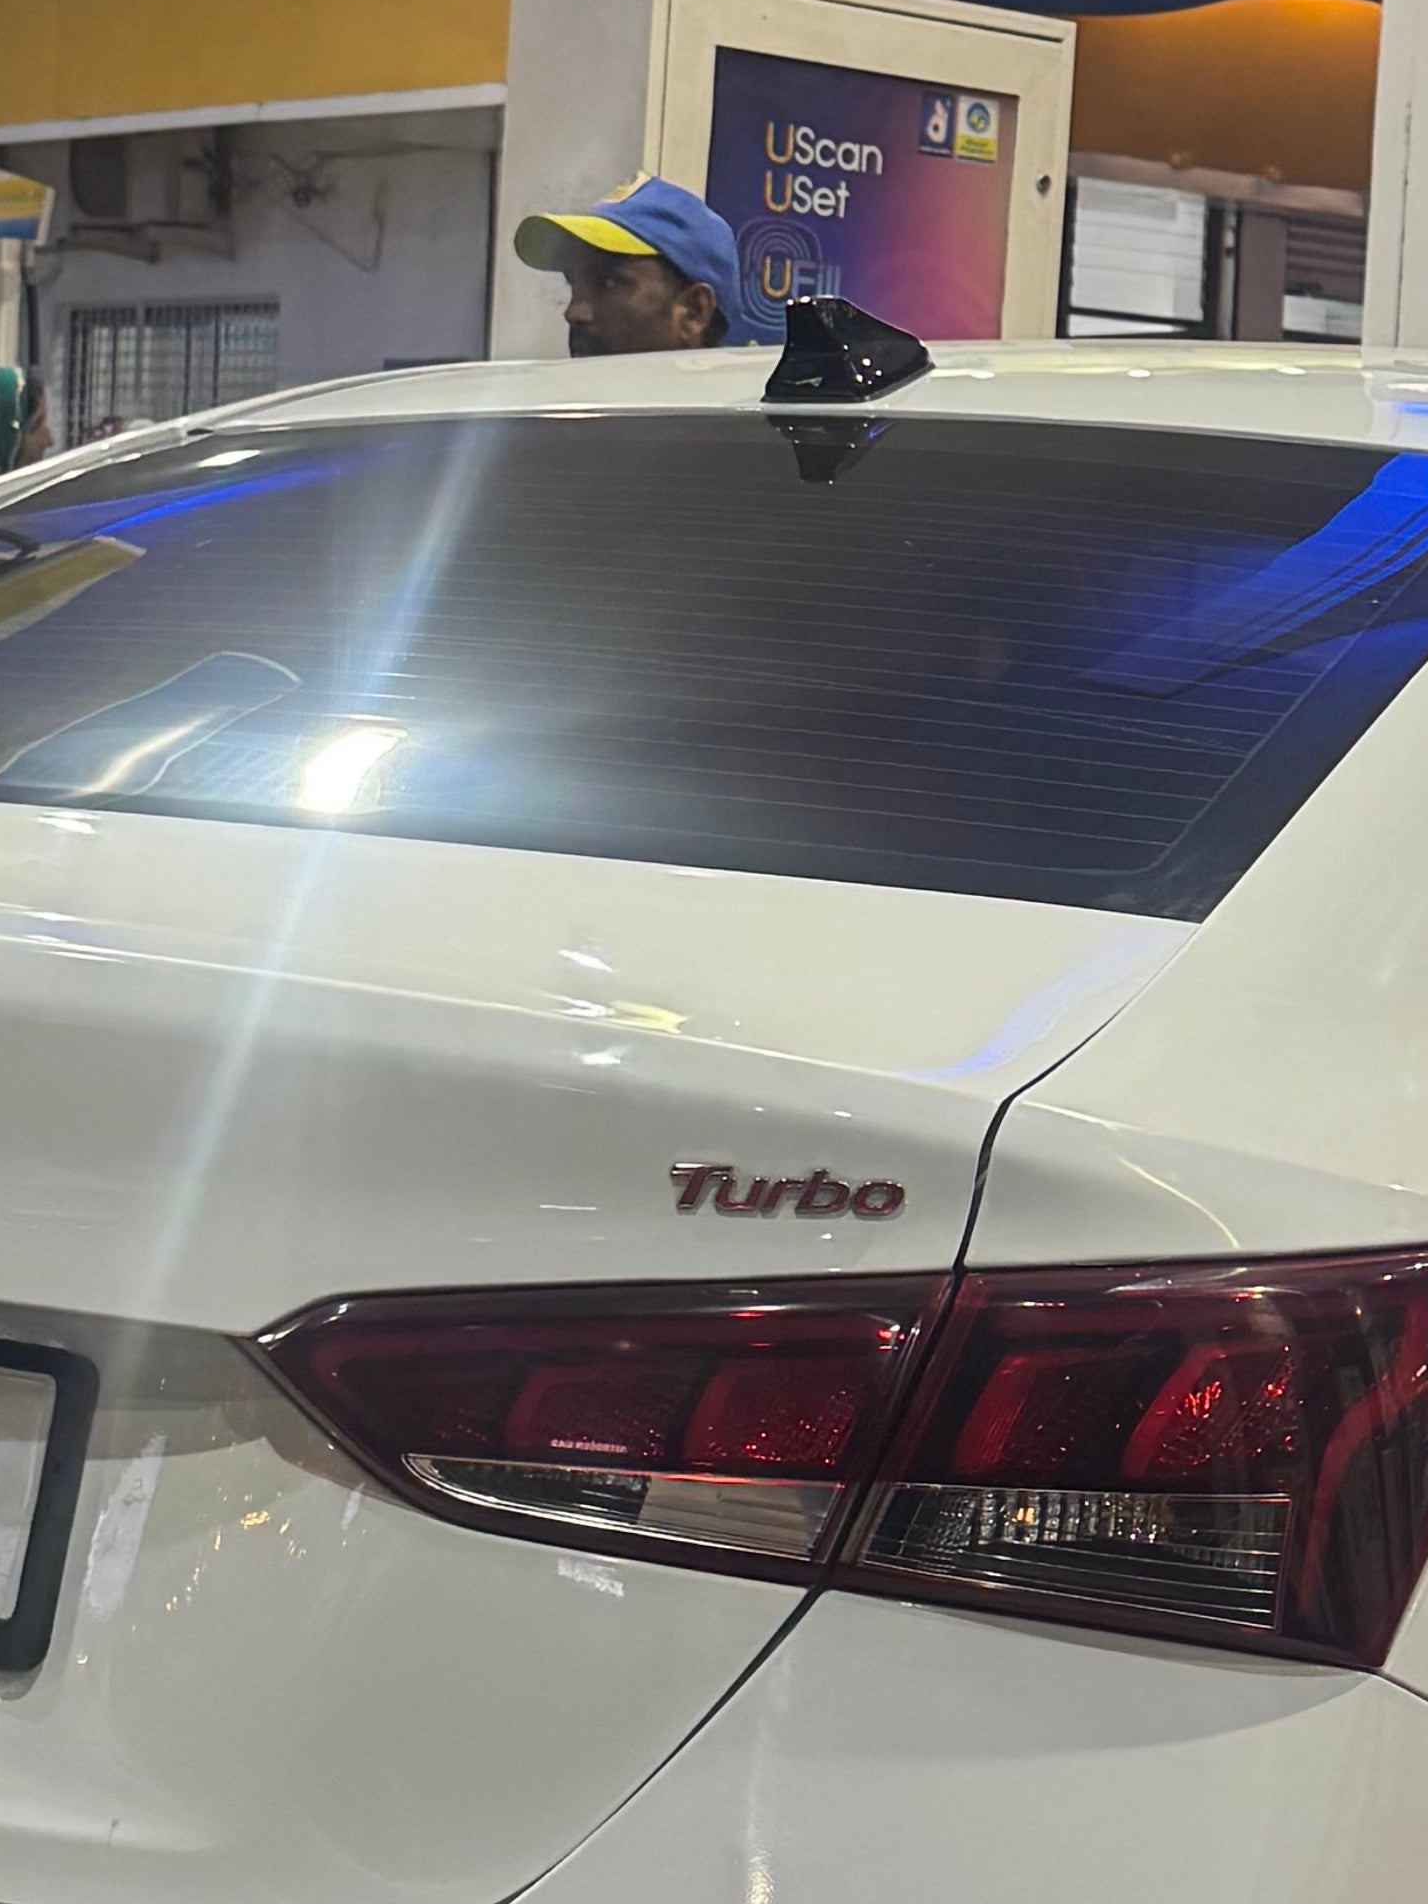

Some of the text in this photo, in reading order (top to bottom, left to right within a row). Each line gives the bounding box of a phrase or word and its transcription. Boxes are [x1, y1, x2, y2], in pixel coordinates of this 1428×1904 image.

[766, 121, 883, 175] UScan
[764, 170, 851, 219] USet
[669, 1162, 907, 1218] Turbo
